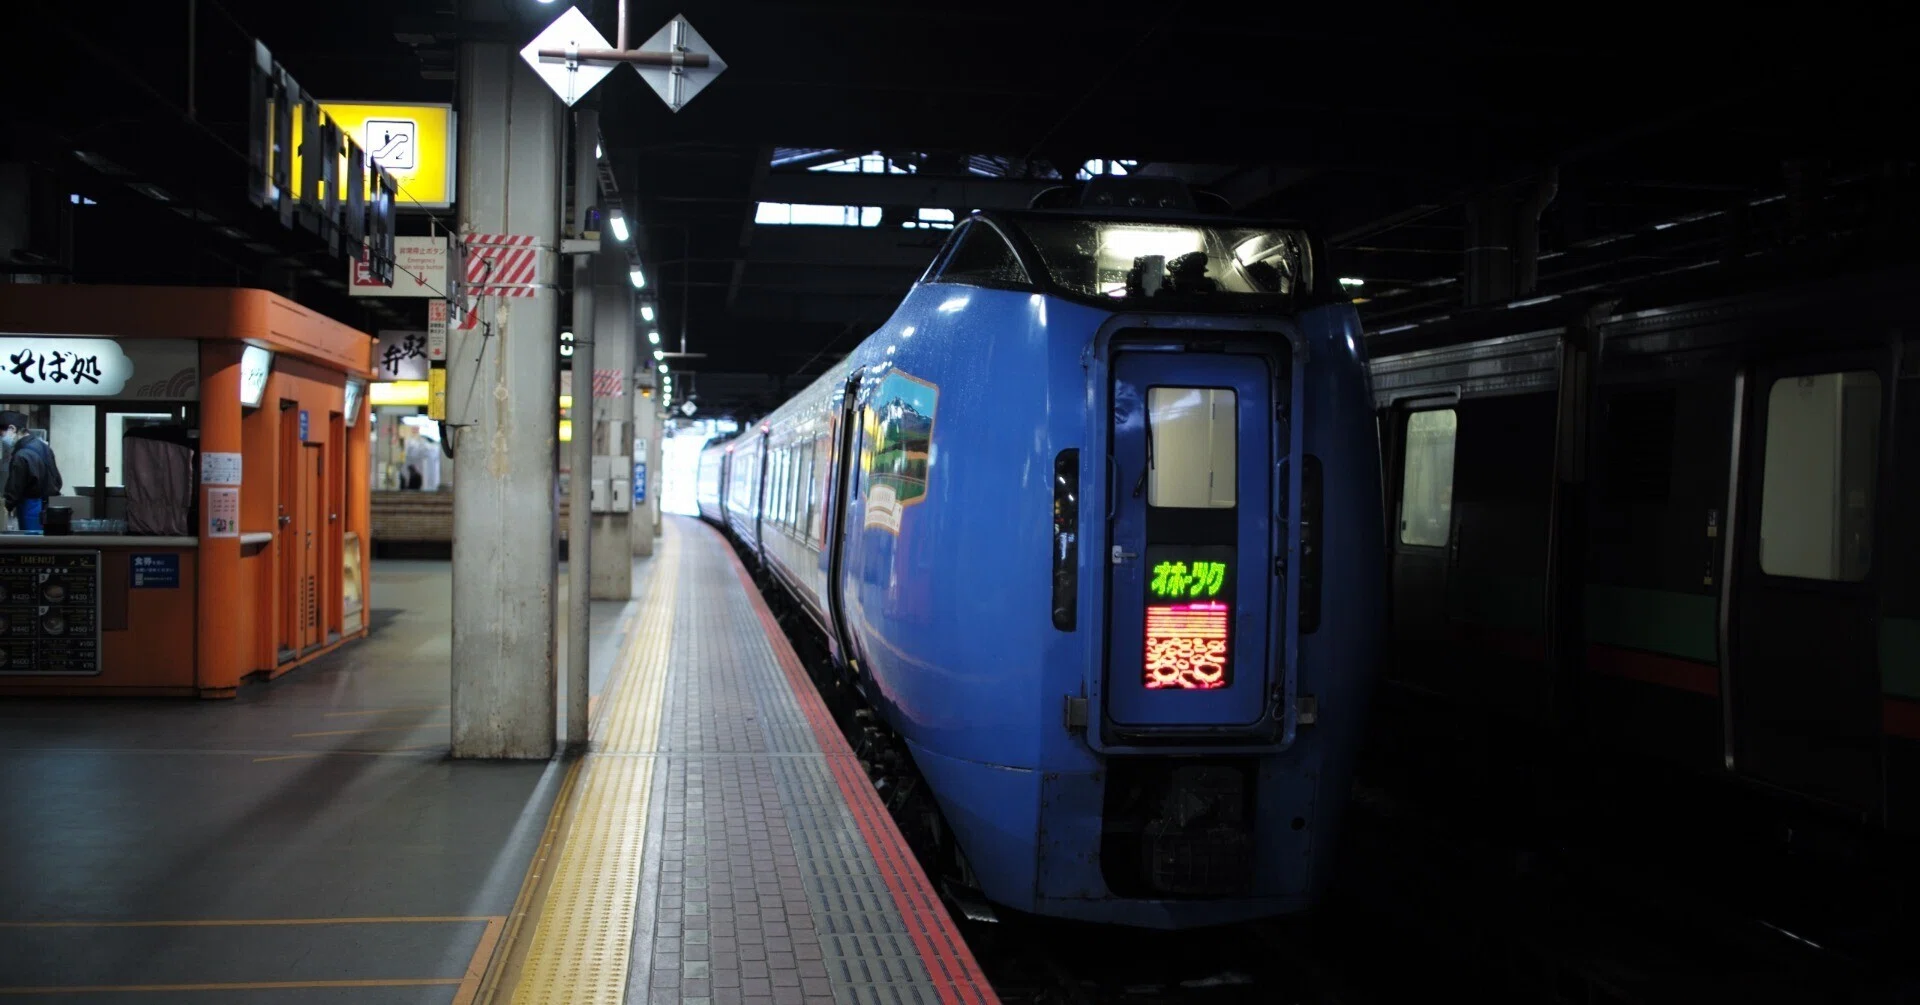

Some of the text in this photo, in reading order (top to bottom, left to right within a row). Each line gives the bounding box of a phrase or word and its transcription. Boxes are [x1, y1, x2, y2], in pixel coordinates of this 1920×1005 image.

[0, 348, 102, 385] そば処
[1151, 561, 1225, 596] オホーツク
